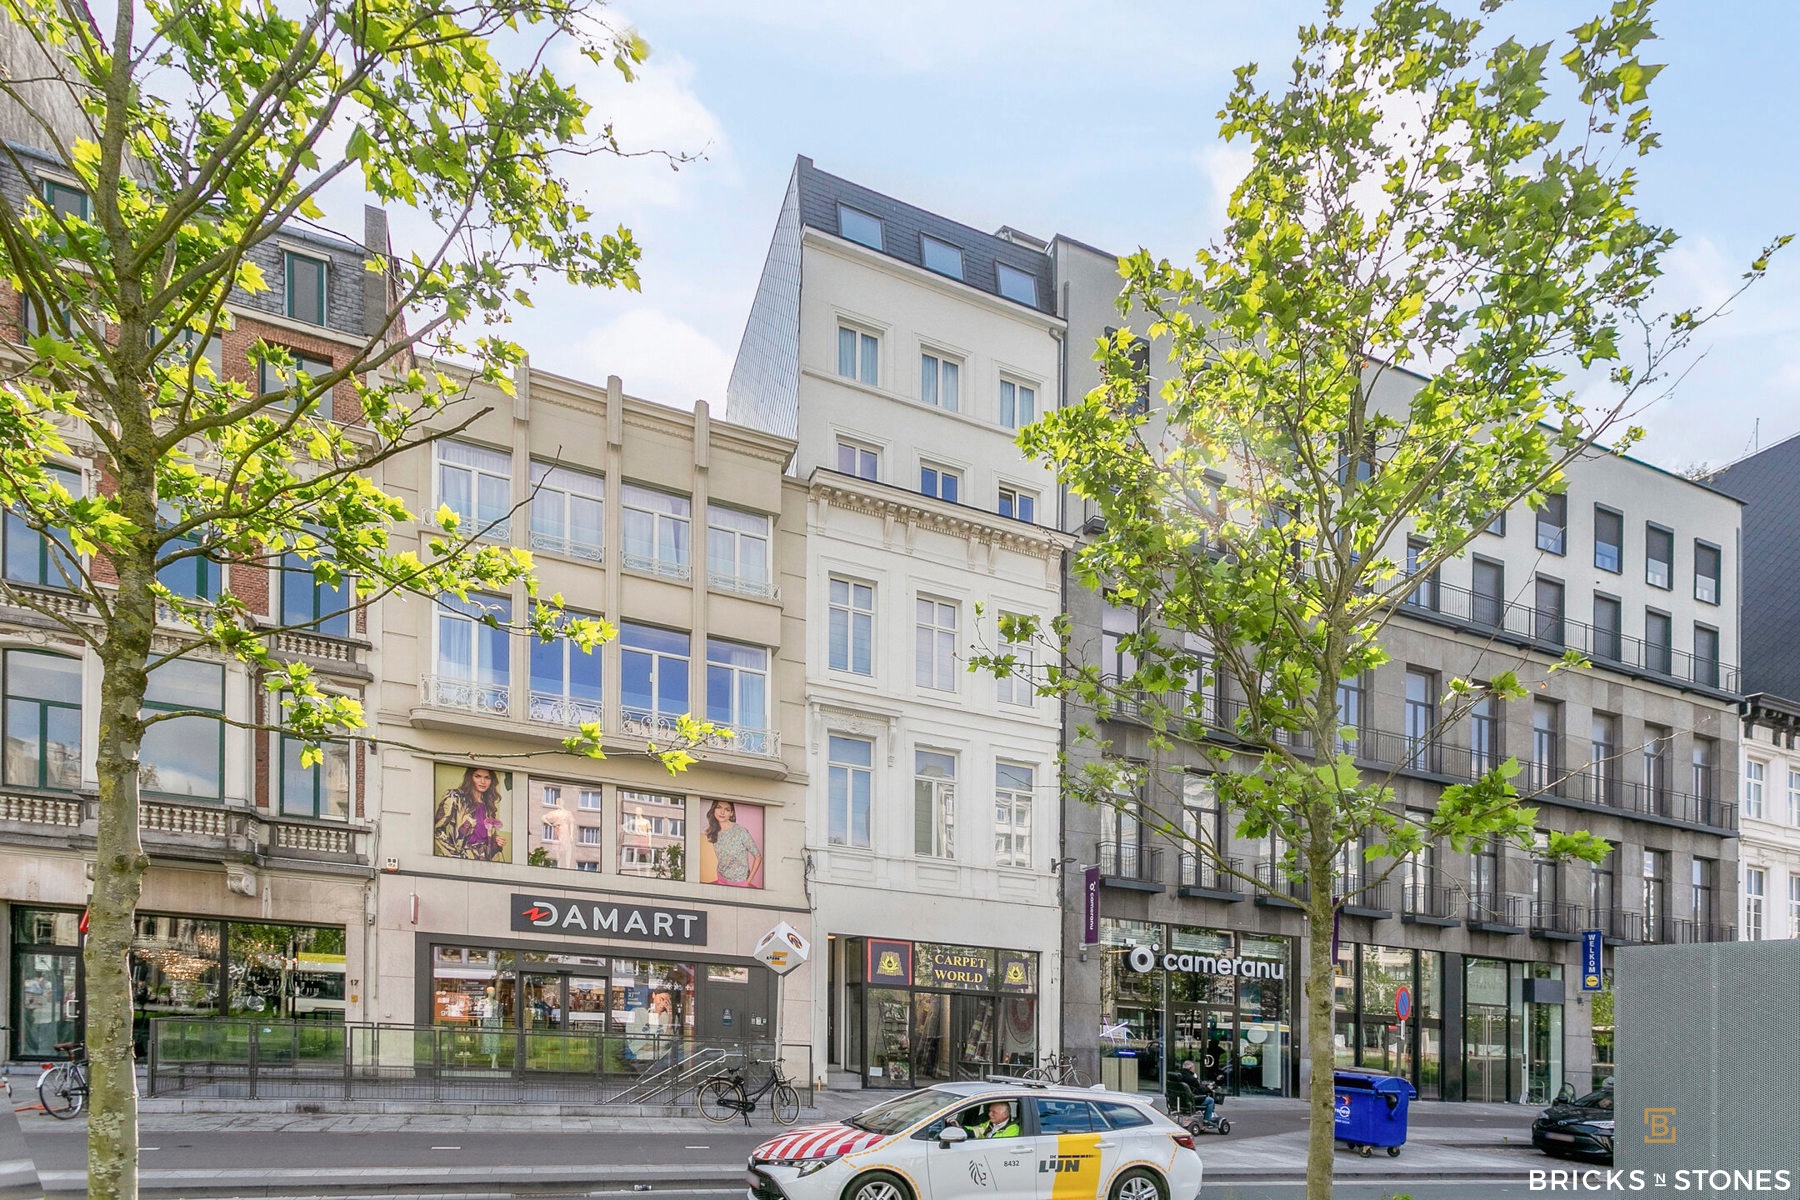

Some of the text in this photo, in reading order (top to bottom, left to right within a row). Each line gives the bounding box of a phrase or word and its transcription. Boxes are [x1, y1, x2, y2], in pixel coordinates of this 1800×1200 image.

[531, 901, 698, 938] DAMART
[934, 954, 987, 969] CARPET
[1588, 934, 1596, 973] WELKOM
[934, 969, 983, 983] WORLD
[1163, 953, 1284, 980] cameranu
[1039, 1160, 1080, 1173] LIJN
